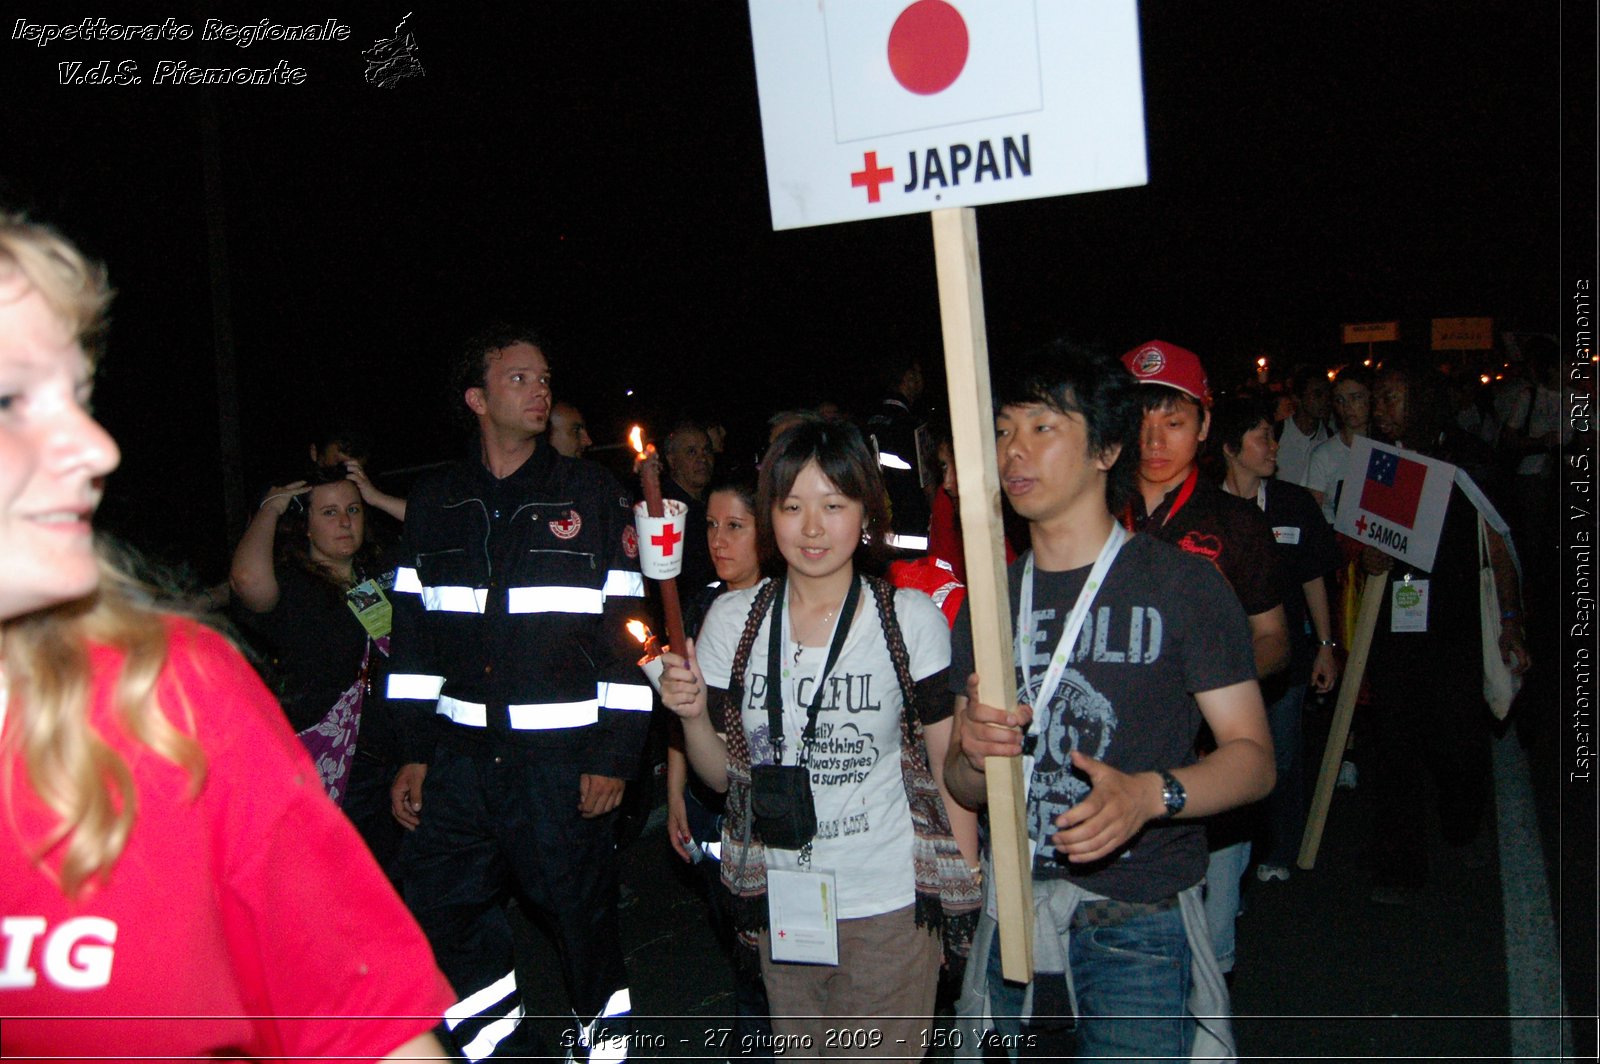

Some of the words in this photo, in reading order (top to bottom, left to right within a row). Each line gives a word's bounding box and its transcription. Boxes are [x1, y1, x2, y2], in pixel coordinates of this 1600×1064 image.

[904, 133, 1032, 193] JAPAN
[1367, 521, 1409, 555] SAMOA
[811, 773, 821, 786] a
[842, 757, 872, 772] gives
[0, 915, 118, 989] IG
